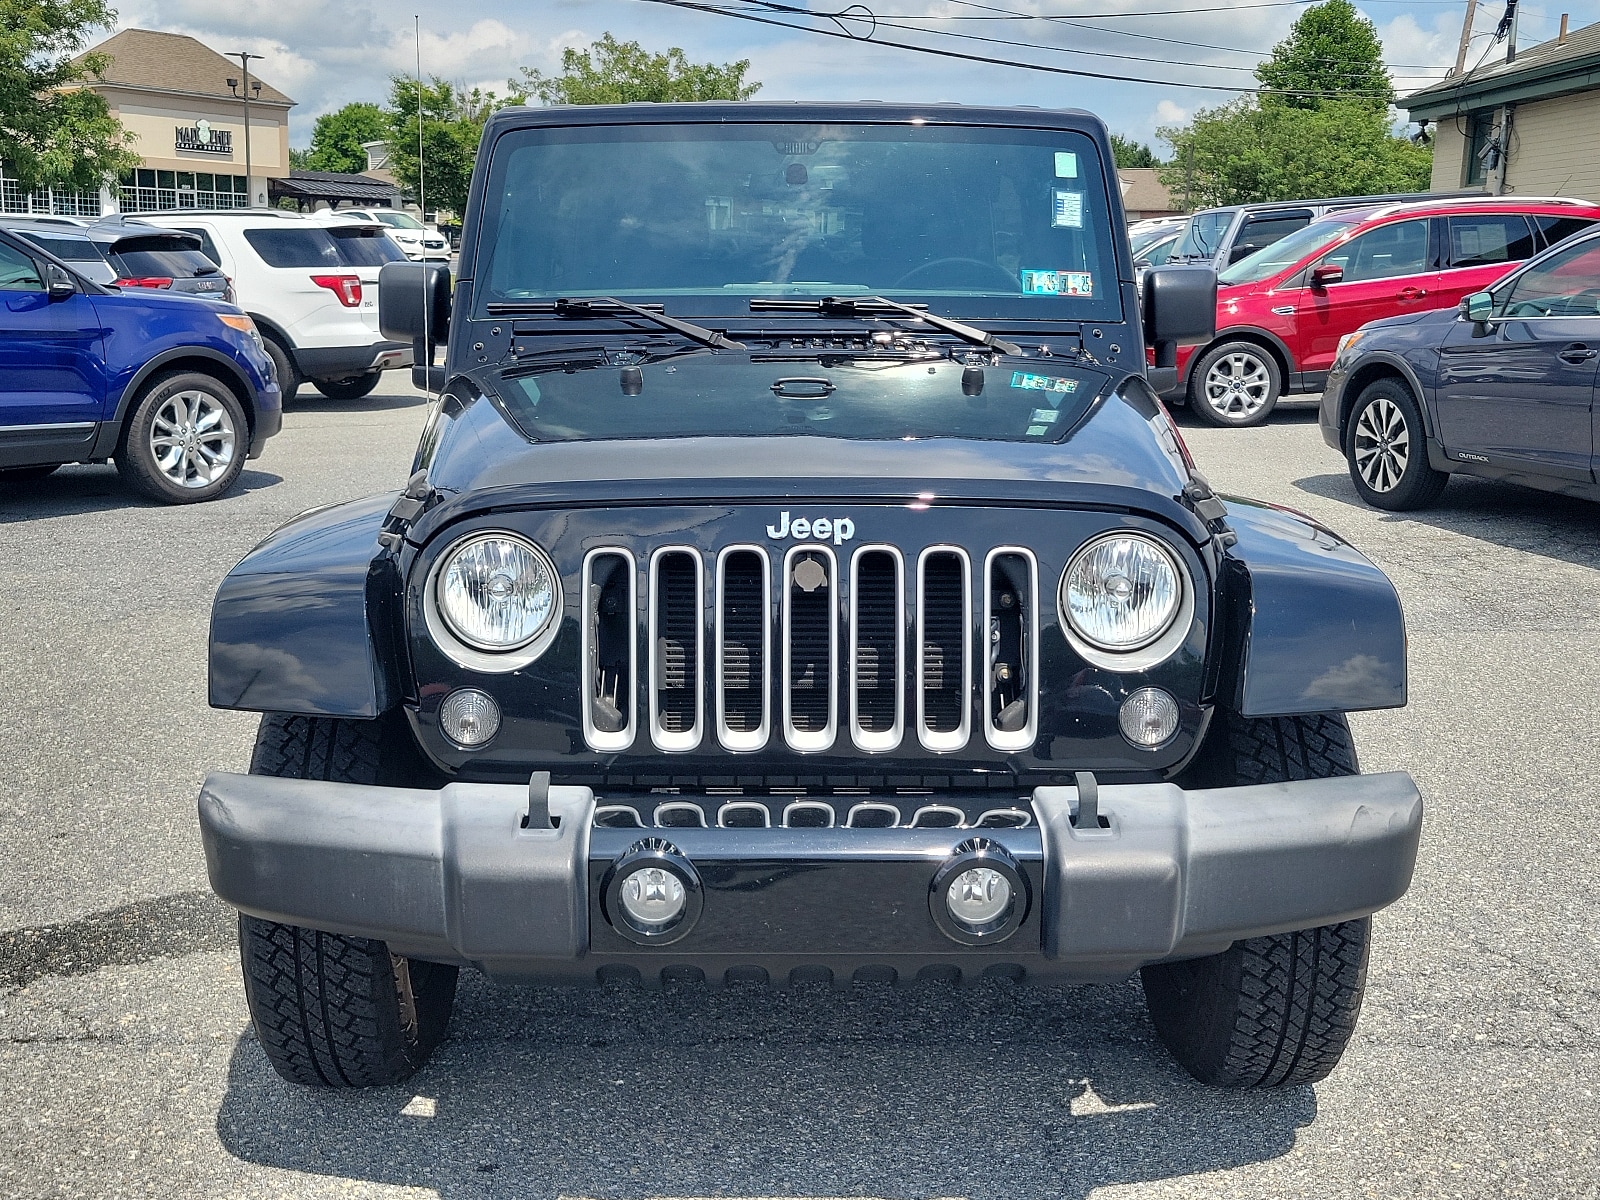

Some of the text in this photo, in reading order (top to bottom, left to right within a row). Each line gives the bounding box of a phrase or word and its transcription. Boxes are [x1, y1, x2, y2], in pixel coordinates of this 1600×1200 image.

[175, 126, 200, 143] MAD
[176, 142, 233, 153] CRAFT BREWING
[1458, 452, 1490, 463] OUTBACK
[766, 511, 855, 546] Jeep
